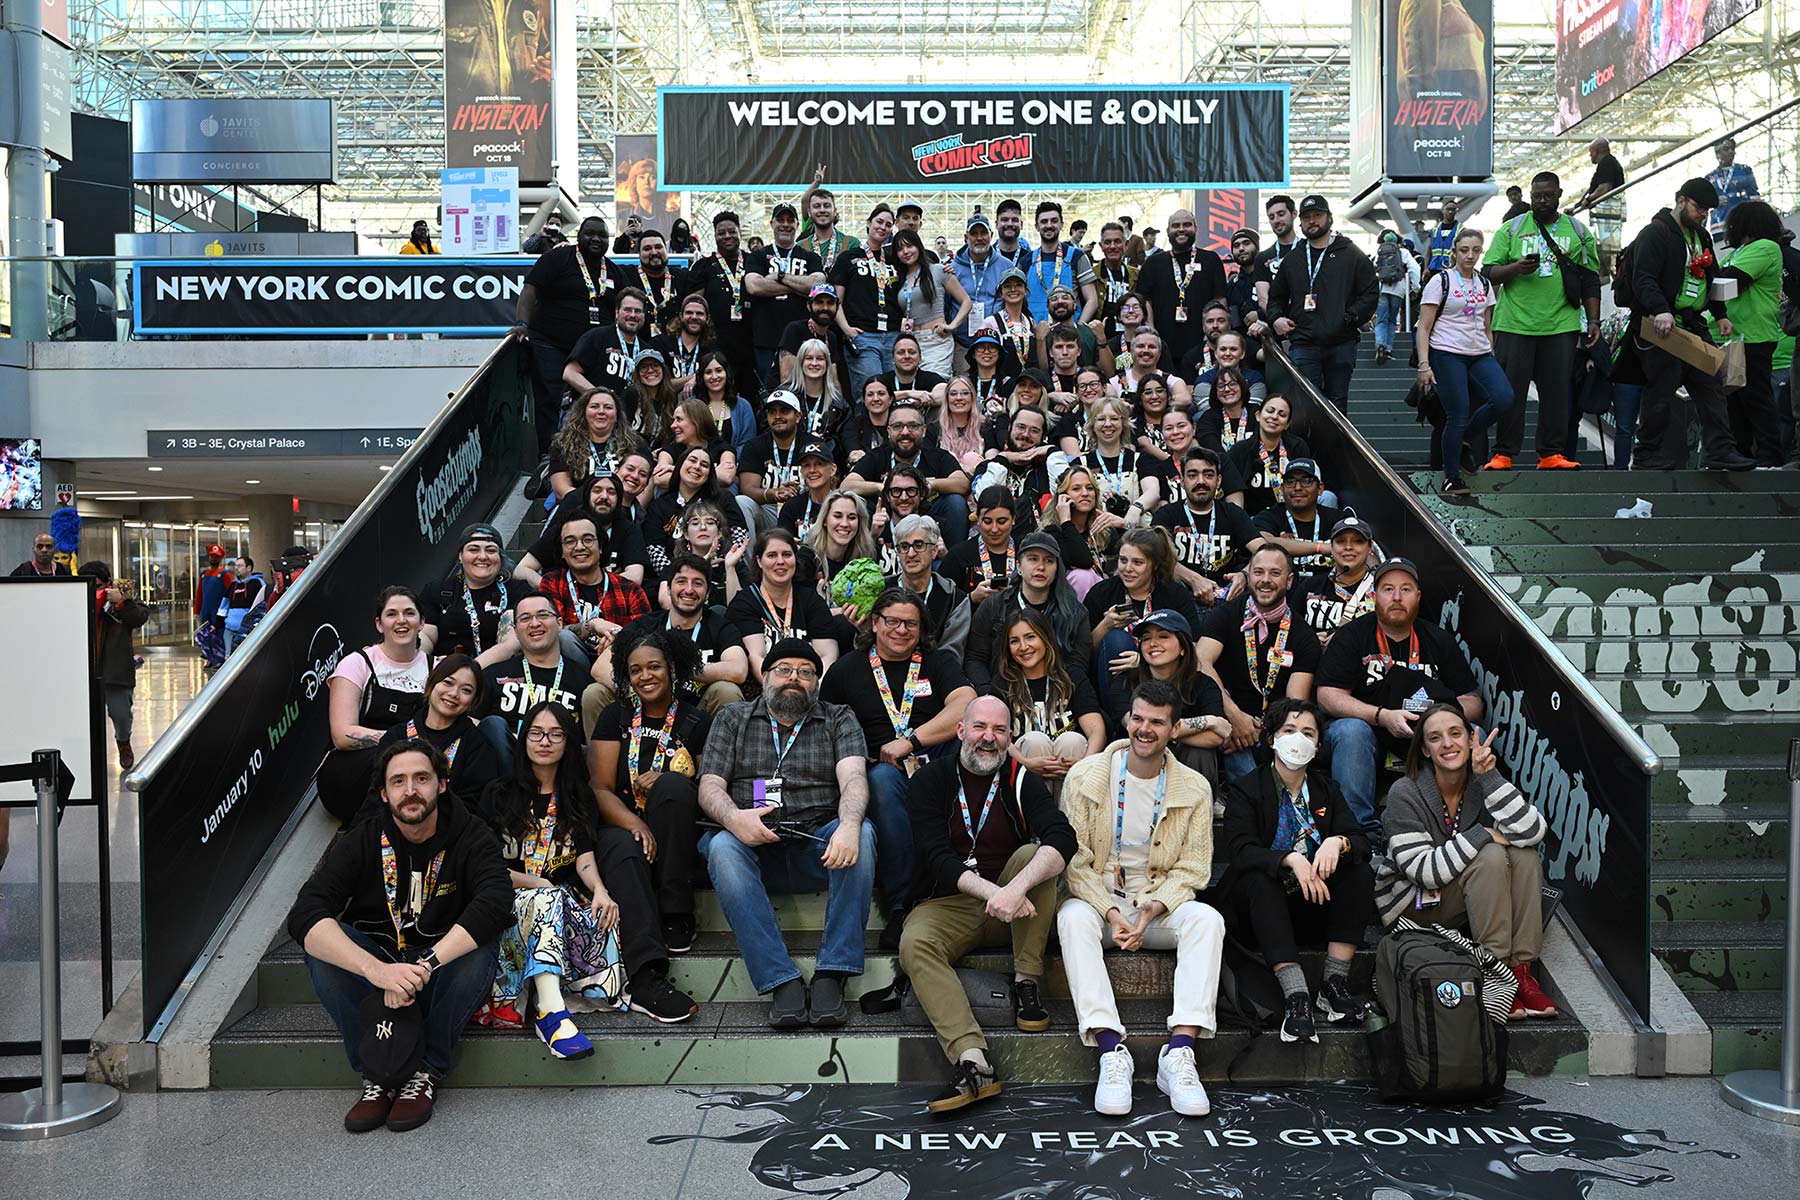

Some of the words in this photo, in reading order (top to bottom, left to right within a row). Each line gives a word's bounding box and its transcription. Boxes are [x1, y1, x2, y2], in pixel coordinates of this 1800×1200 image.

[1581, 64, 1616, 96] britbox
[222, 117, 262, 128] JAVITS
[451, 102, 549, 136] HYSTERIA!
[728, 99, 895, 127] WELCOME
[901, 99, 947, 127] TO
[951, 99, 1015, 126] THE
[1021, 99, 1093, 126] ONE
[1101, 99, 1125, 126] &
[1130, 99, 1220, 126] ONLY
[1393, 99, 1489, 131] HYSTERIA!
[473, 141, 522, 157] peacock
[914, 142, 936, 158] NEW
[936, 135, 962, 151] YORK
[921, 143, 985, 175] COMIC
[988, 135, 1029, 163] CON
[1413, 136, 1461, 152] peacock
[1426, 150, 1442, 158] OCT
[1443, 150, 1452, 158] 18
[202, 162, 261, 170] CONCIERGE
[169, 184, 217, 224] ONLY
[227, 242, 266, 253] JAVITS
[1521, 236, 1571, 256] CRW
[768, 257, 808, 277] SFF
[156, 275, 232, 300] NEW
[235, 275, 330, 300] YORK
[335, 275, 445, 301] COMIC
[451, 275, 524, 301] CON
[182, 438, 197, 448] 3B
[208, 438, 226, 450] 3E,
[228, 437, 266, 450] Crystal
[269, 437, 305, 448] Palace
[376, 436, 394, 449] 1E,
[57, 484, 73, 492] AED
[416, 423, 482, 545] Goosebumps
[1304, 599, 1344, 631] STA
[300, 638, 346, 701] Disney+
[267, 700, 300, 751] hulu
[201, 769, 249, 844] January
[249, 748, 263, 776] 10
[809, 1133, 852, 1150] A
[874, 1131, 1008, 1150] NEW
[1030, 1131, 1185, 1150] FEAR
[1202, 1129, 1259, 1147] IS
[1278, 1125, 1577, 1147] GROWING
